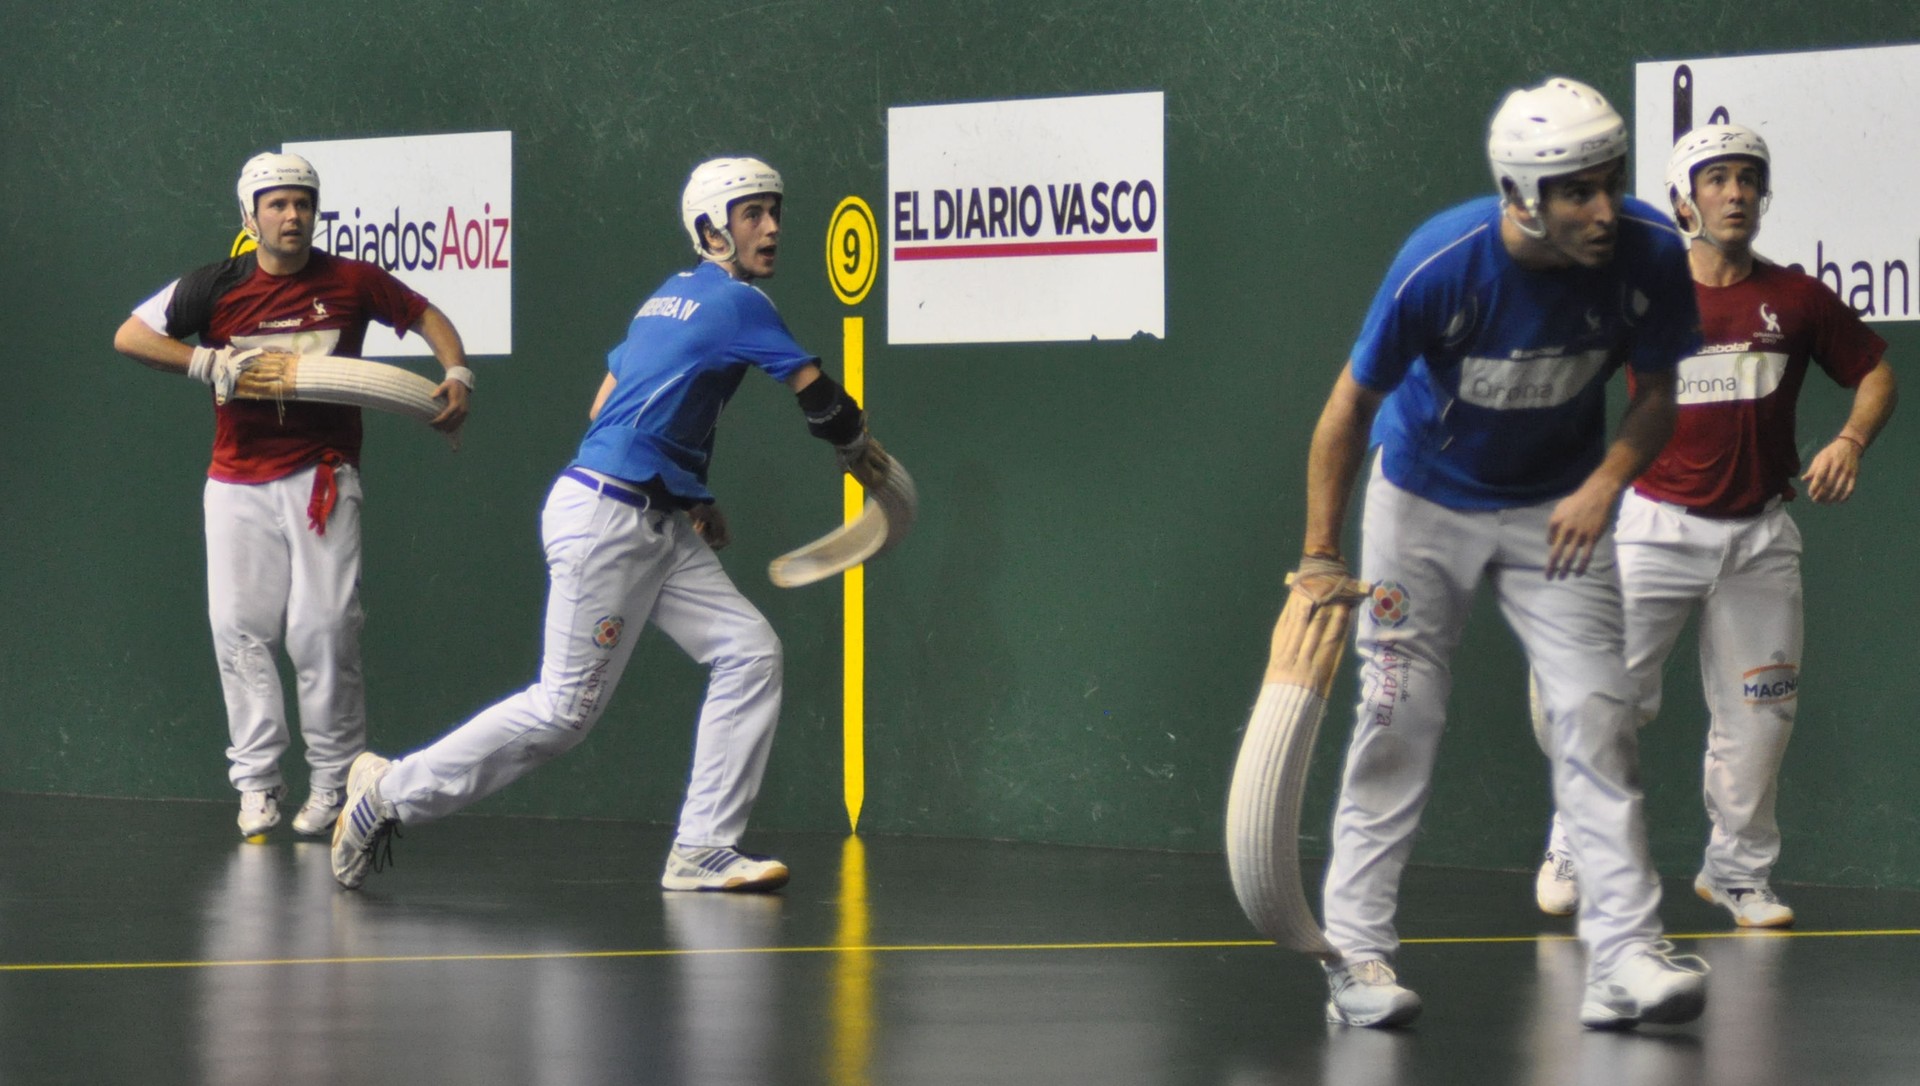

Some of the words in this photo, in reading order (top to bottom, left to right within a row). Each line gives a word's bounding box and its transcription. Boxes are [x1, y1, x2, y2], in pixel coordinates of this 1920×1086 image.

[894, 190, 929, 241] EL
[934, 185, 1042, 240] DIARIO
[1047, 179, 1158, 236] VASCO
[842, 227, 861, 275] 9
[1743, 679, 1799, 698] MAGN
